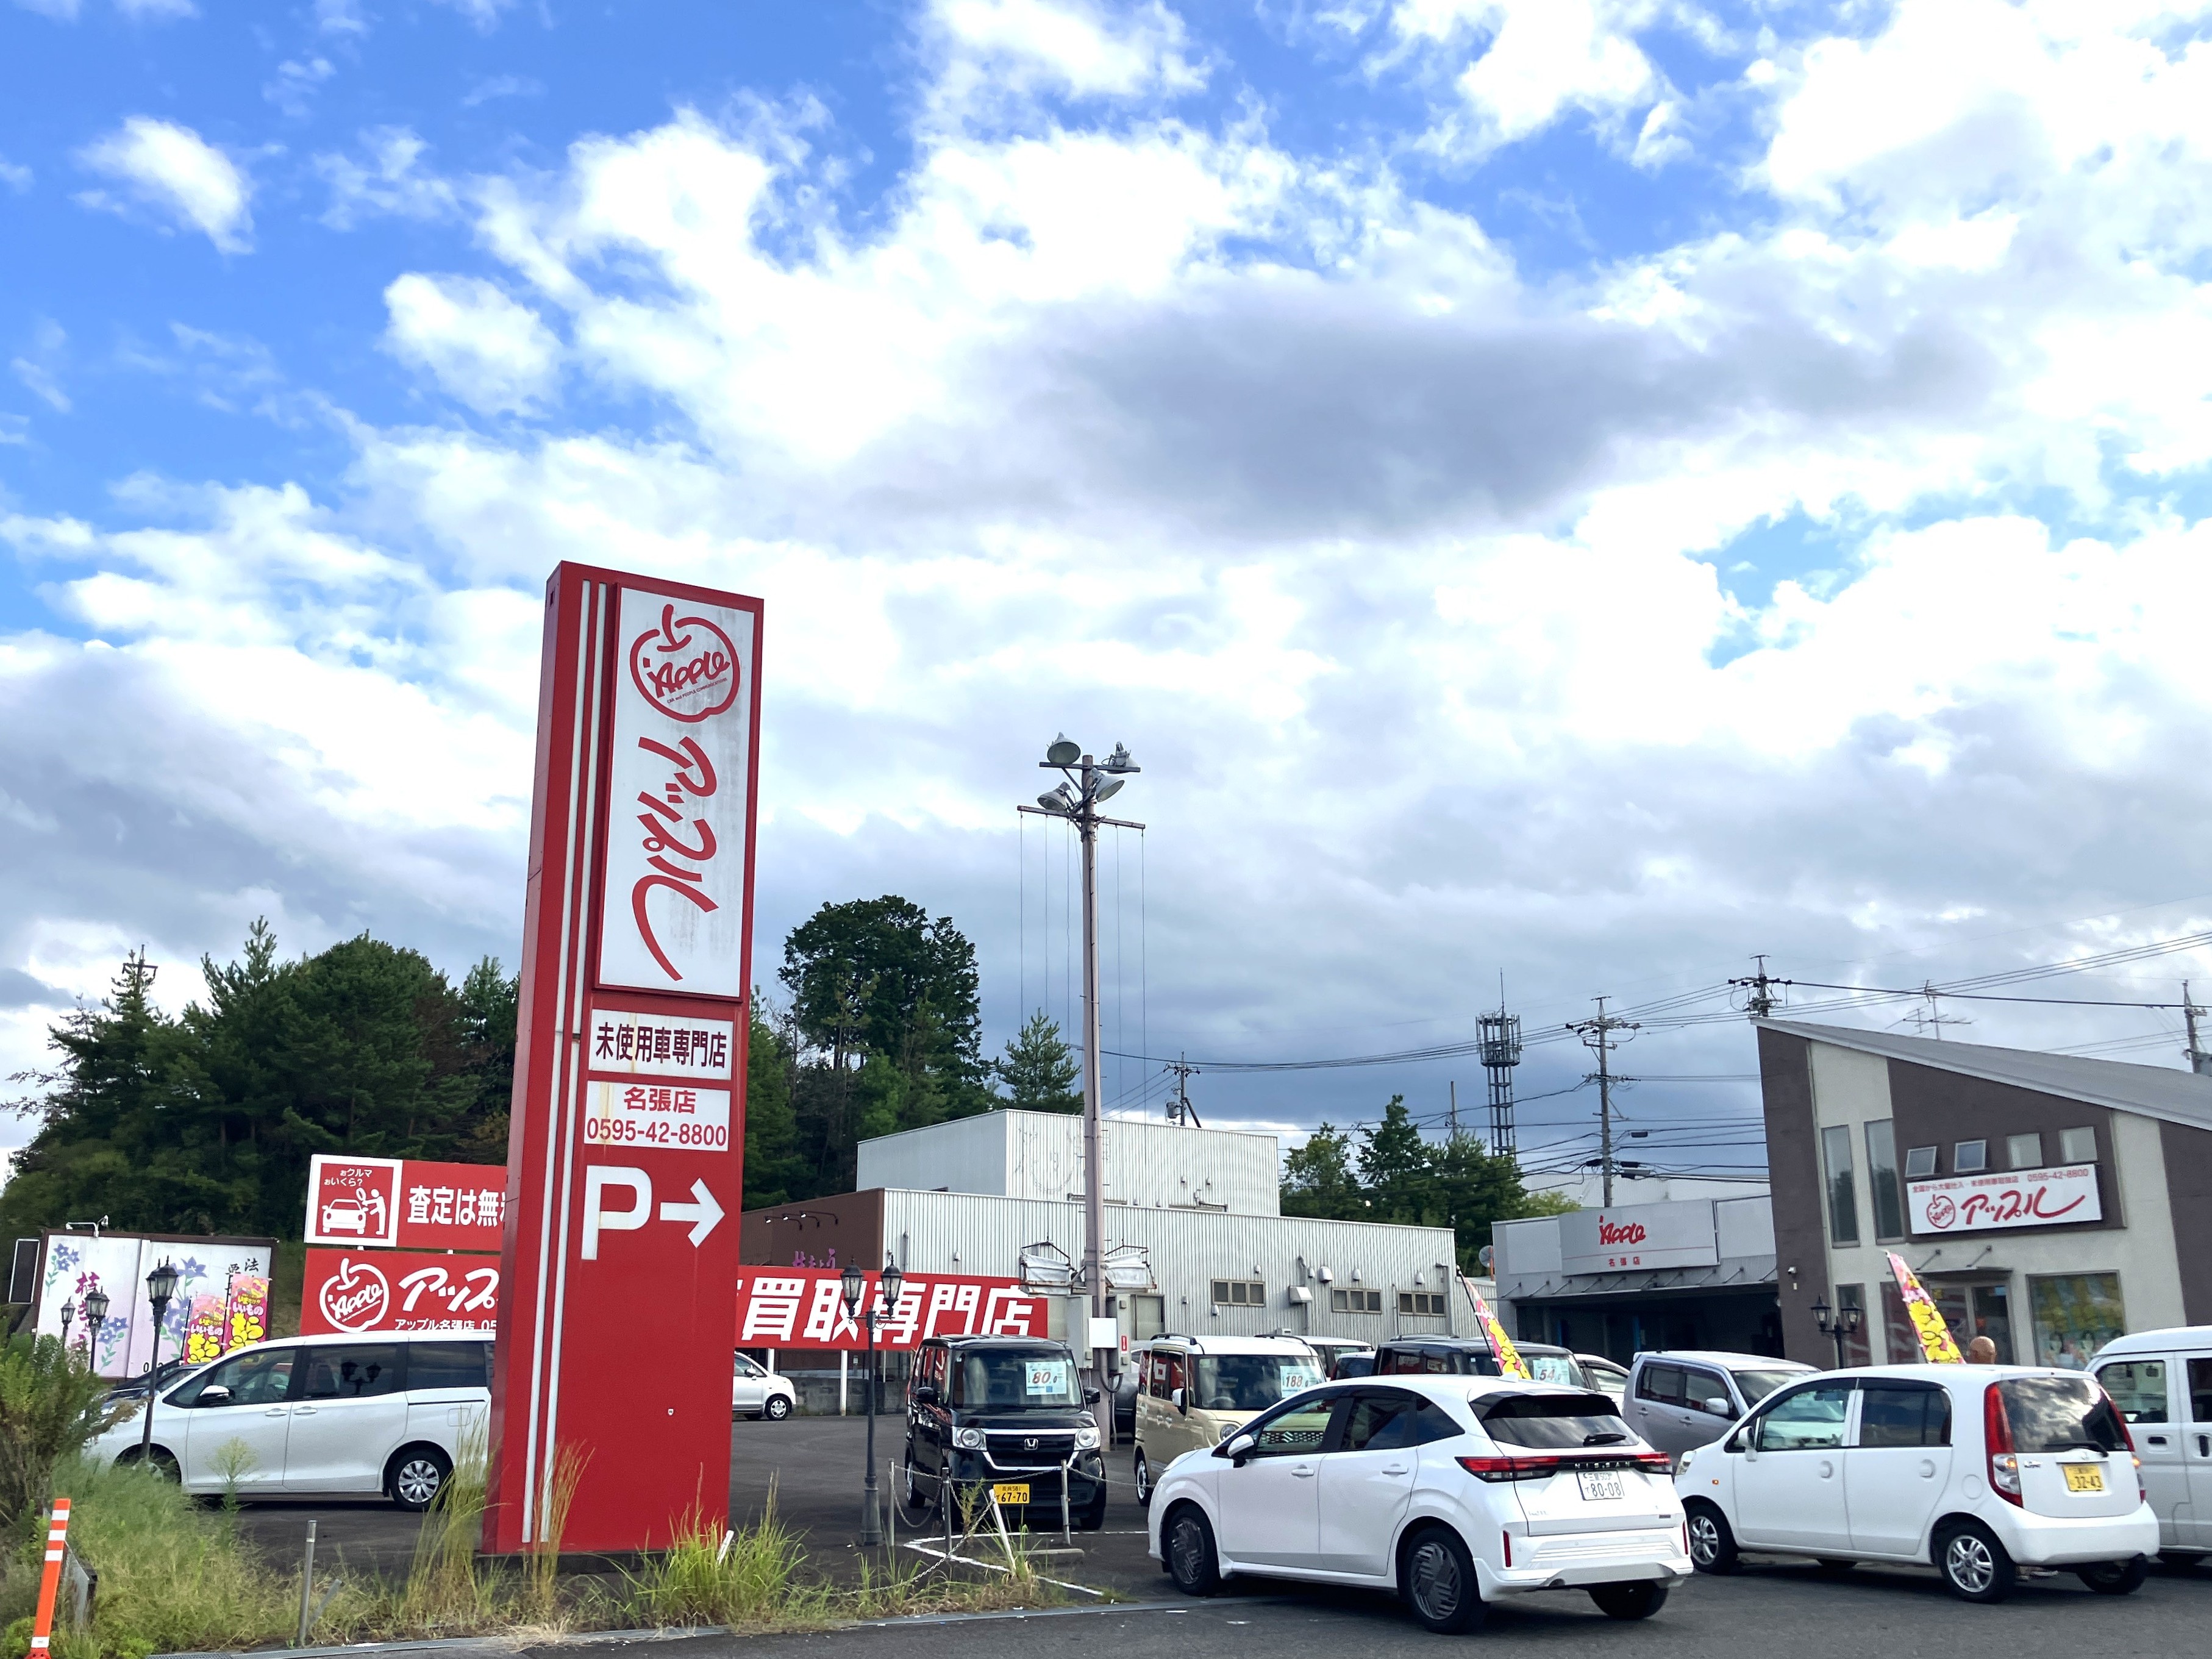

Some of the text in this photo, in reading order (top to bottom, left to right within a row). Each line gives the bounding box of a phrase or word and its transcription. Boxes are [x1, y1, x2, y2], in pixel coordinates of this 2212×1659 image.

[632, 735, 719, 982] アップル
[595, 1021, 727, 1069] 未使用車専門店
[624, 1086, 696, 1114] 名張店
[587, 1118, 727, 1146] 0595-42-8800
[407, 1185, 506, 1227] 査定は無
[581, 1165, 652, 1260] P
[1960, 1186, 2086, 1225] アップル
[737, 1277, 1036, 1344] 買取専門店
